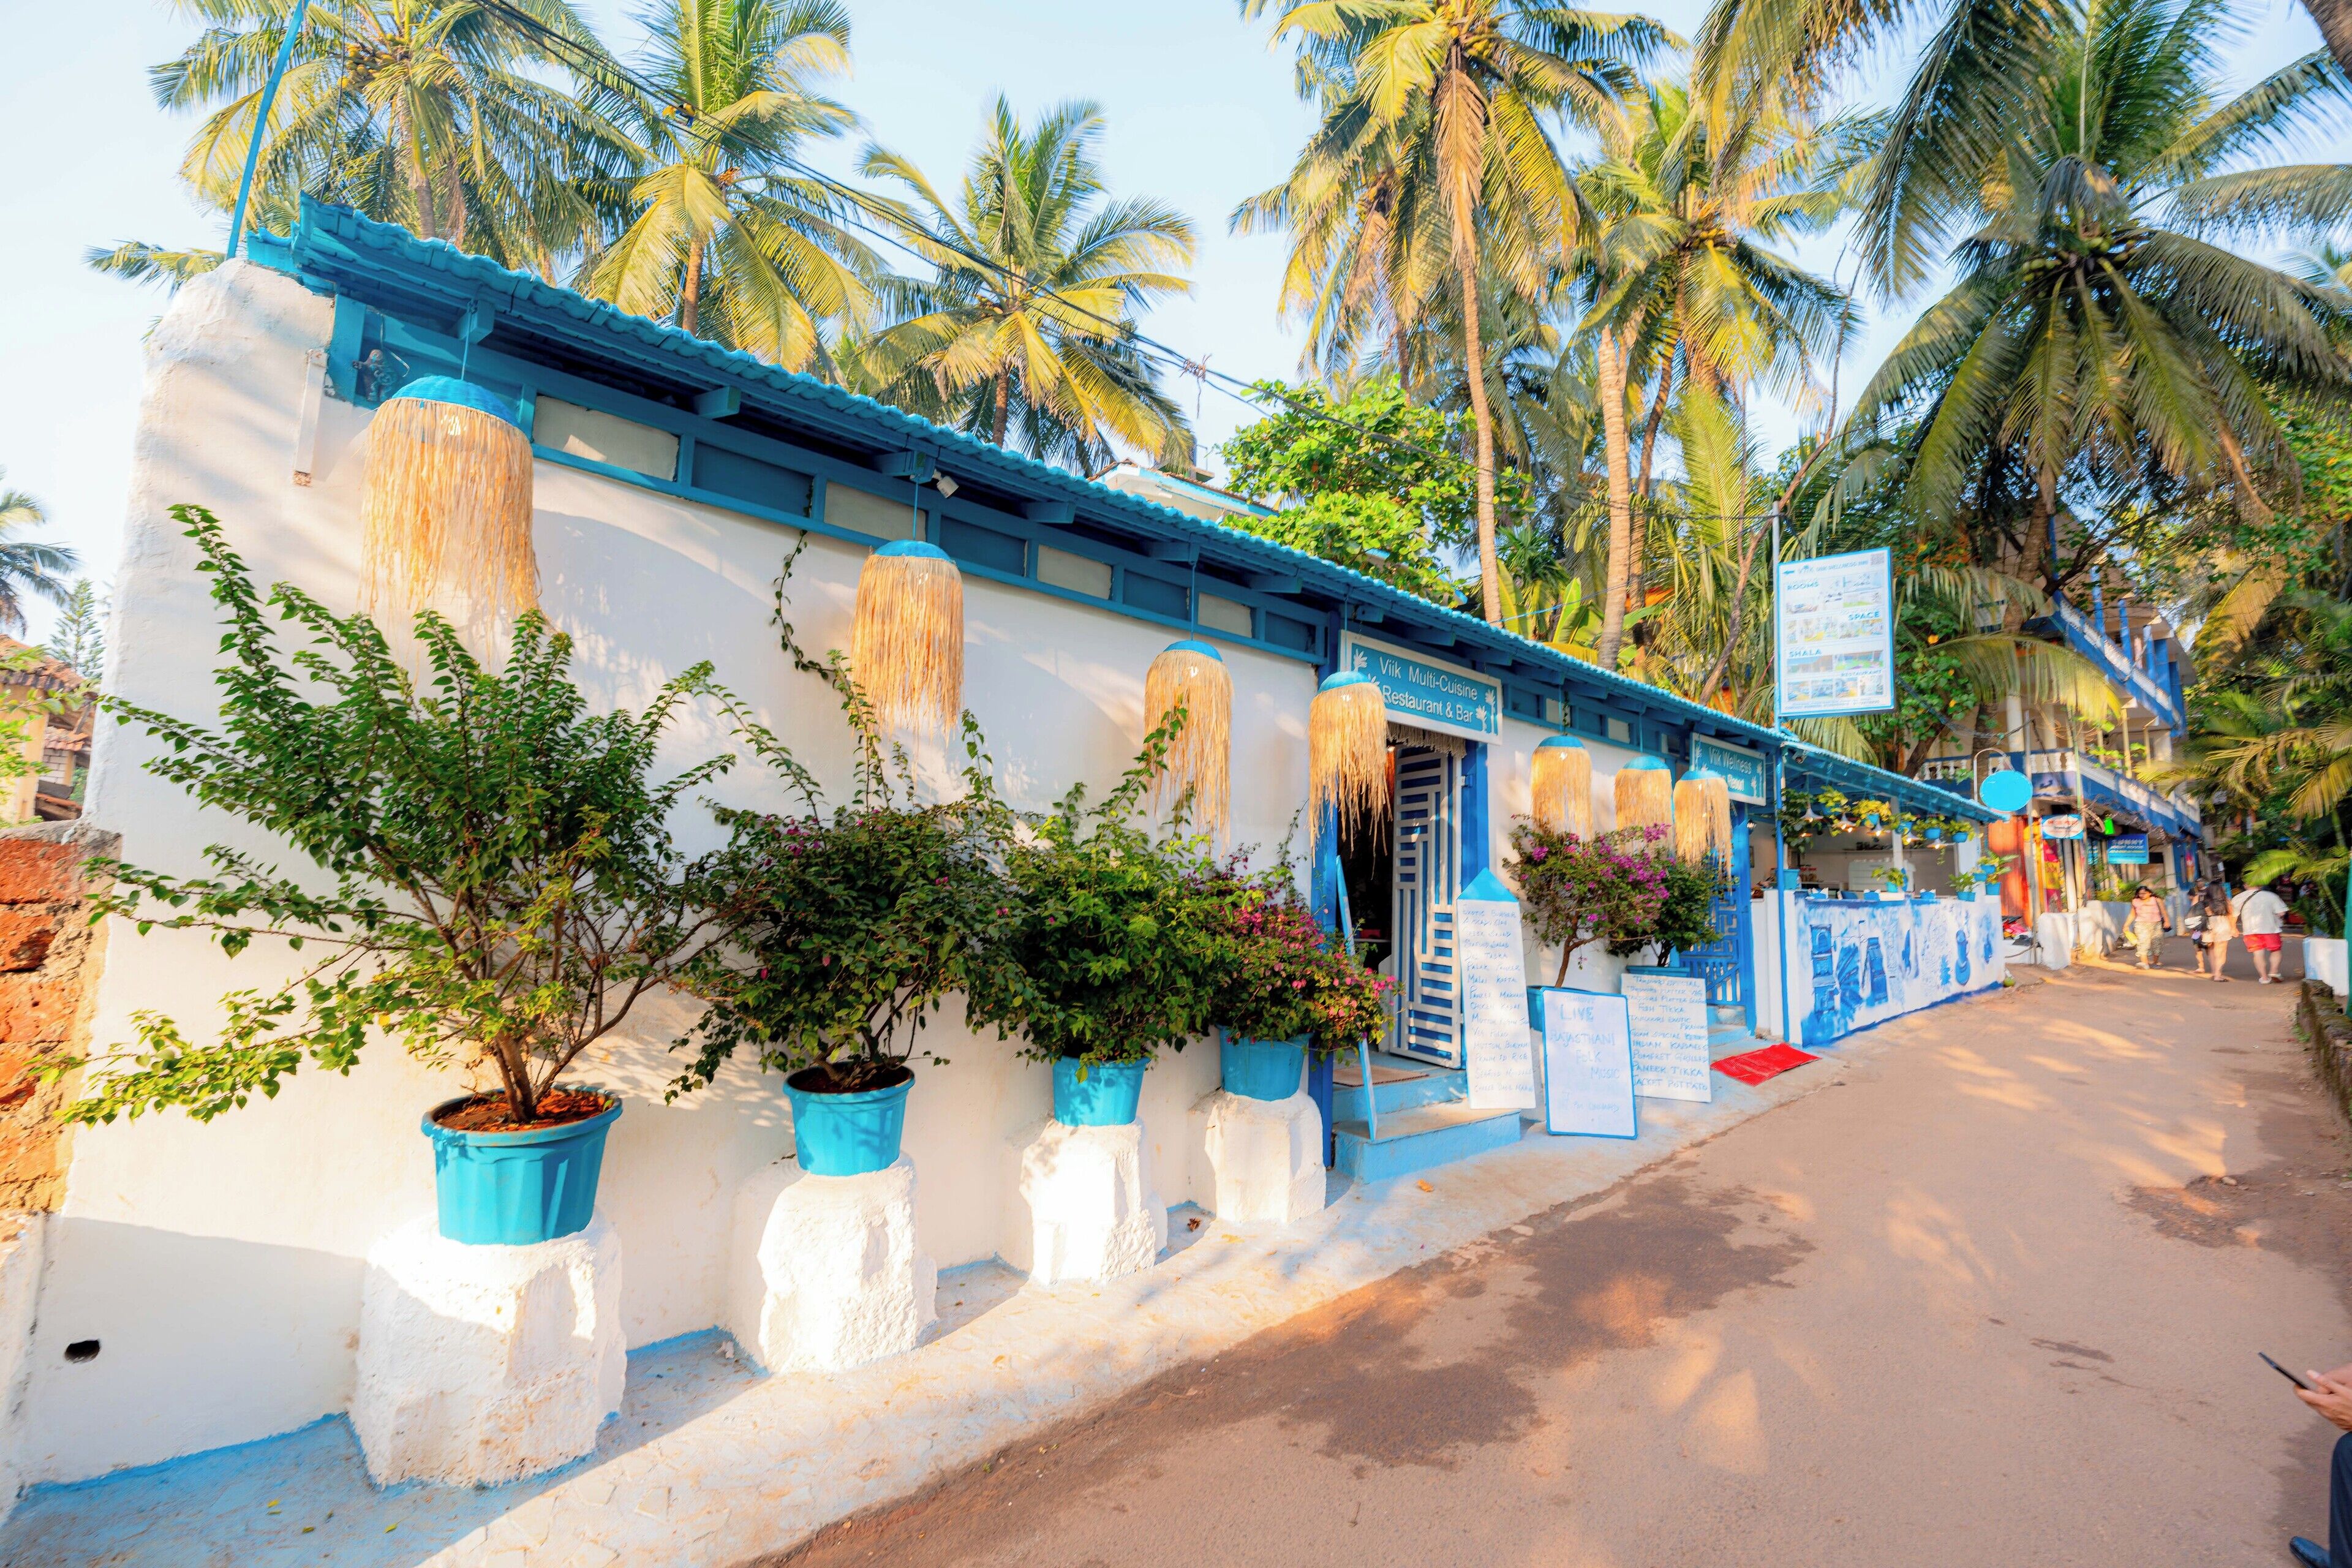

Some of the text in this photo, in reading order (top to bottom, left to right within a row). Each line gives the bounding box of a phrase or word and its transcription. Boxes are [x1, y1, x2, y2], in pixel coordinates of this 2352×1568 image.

[1787, 581, 1819, 591] ROOMS
[1848, 611, 1880, 620] SPACE
[1789, 648, 1822, 657] SHALA
[1379, 656, 1478, 701] Viik Multi-Cuisine
[1382, 685, 1473, 723] Restaurant & Bar
[1722, 752, 1752, 774] Wellness
[1559, 1004, 1594, 1022] LIVE
[1550, 1030, 1615, 1047] RAJASTHANI
[1575, 1049, 1602, 1064] FOLK
[1590, 1067, 1619, 1080] MUSIC
[1670, 1066, 1704, 1077] TIKKA
